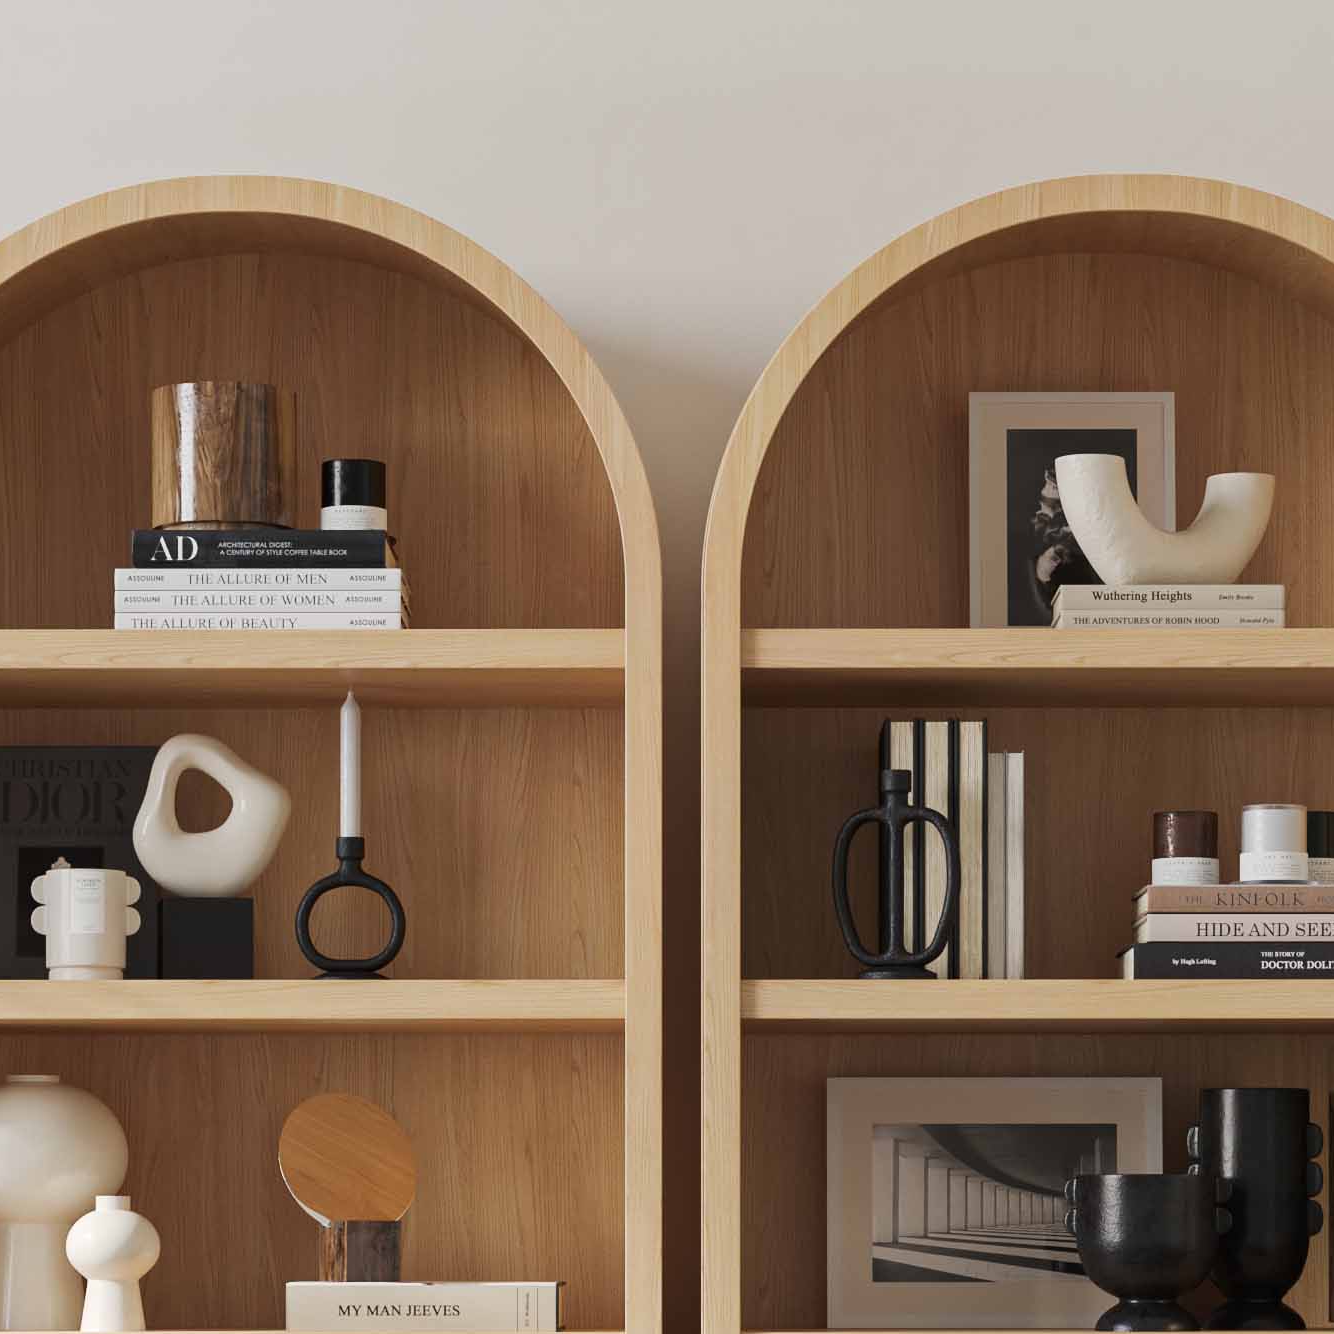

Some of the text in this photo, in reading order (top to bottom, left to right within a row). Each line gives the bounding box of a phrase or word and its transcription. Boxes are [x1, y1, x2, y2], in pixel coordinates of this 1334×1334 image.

[151, 535, 198, 561] AD
[218, 541, 268, 549] ARCHITECTURAL
[187, 574, 328, 585] THE ALLURE OF MEN
[171, 595, 335, 606] THE ALLURE OF WOMEN
[1091, 591, 1192, 603] Wuthering Heights
[131, 618, 298, 629] THE ALLURE OF BEAUTY
[1073, 617, 1220, 625] THE ADVENTURES OF ROBIN HOOD
[1, 780, 130, 824] DIOR
[1216, 892, 1305, 906] KINFOLK
[1196, 922, 1244, 937] HIDE
[1249, 922, 1290, 937] AND
[1261, 960, 1304, 970] DOCTOR
[338, 1304, 461, 1317] MY MAN JEEVES
